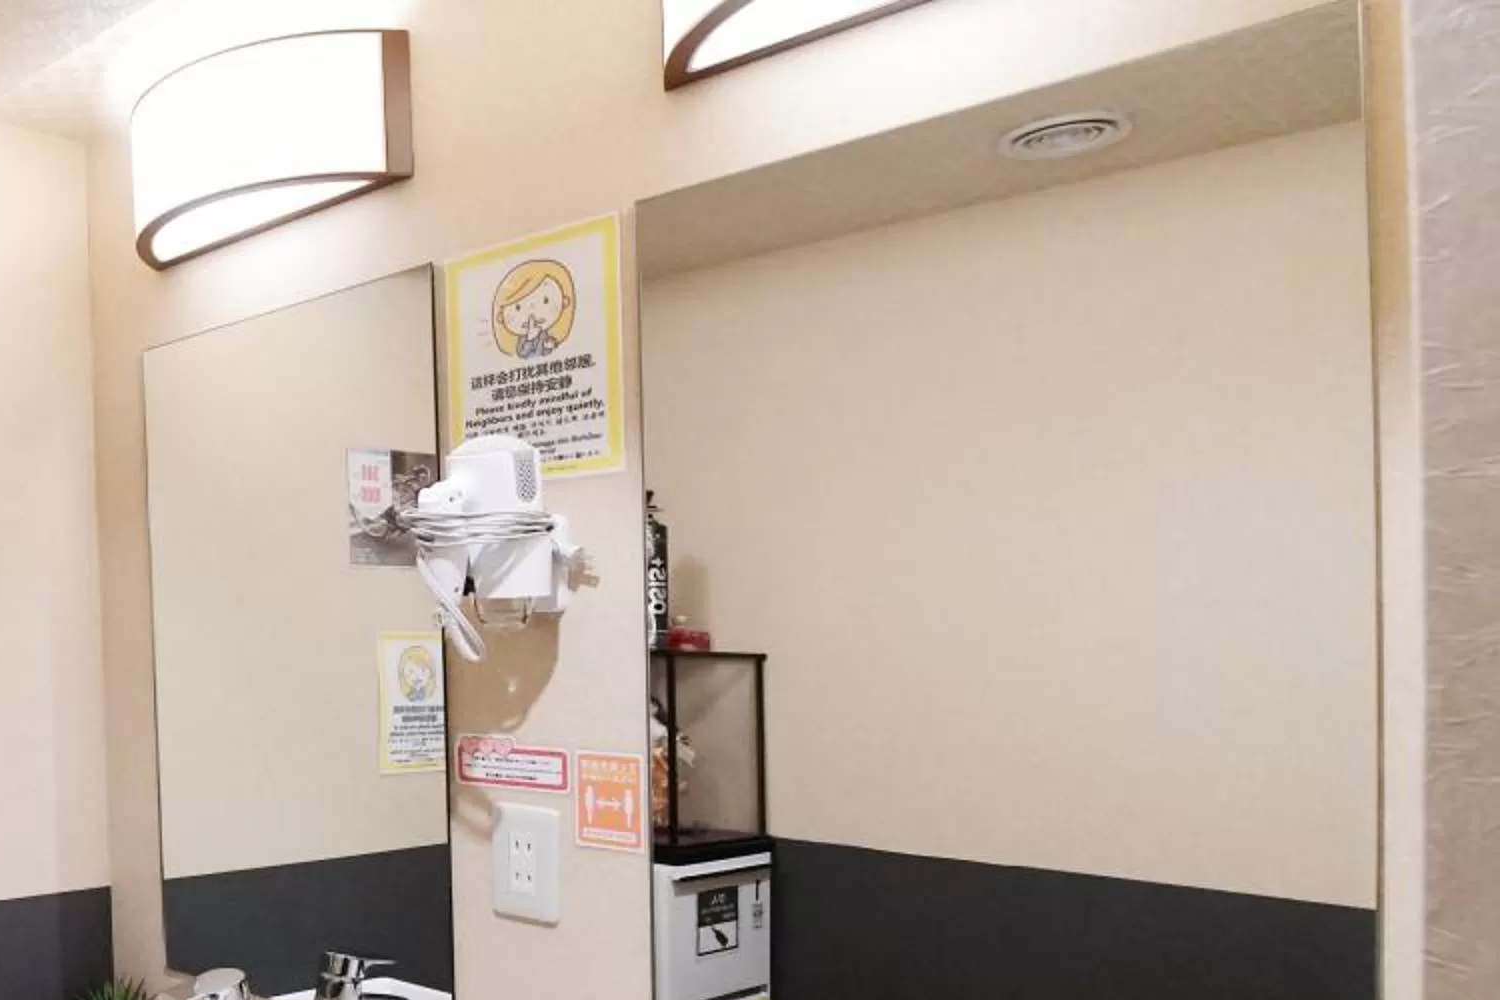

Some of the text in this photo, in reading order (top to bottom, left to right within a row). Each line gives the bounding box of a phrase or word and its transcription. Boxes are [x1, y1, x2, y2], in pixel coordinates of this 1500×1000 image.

[475, 405, 504, 416] Please
[507, 398, 536, 411] kindly
[581, 386, 592, 397] of
[516, 409, 533, 420] and
[536, 406, 562, 418] enjoy
